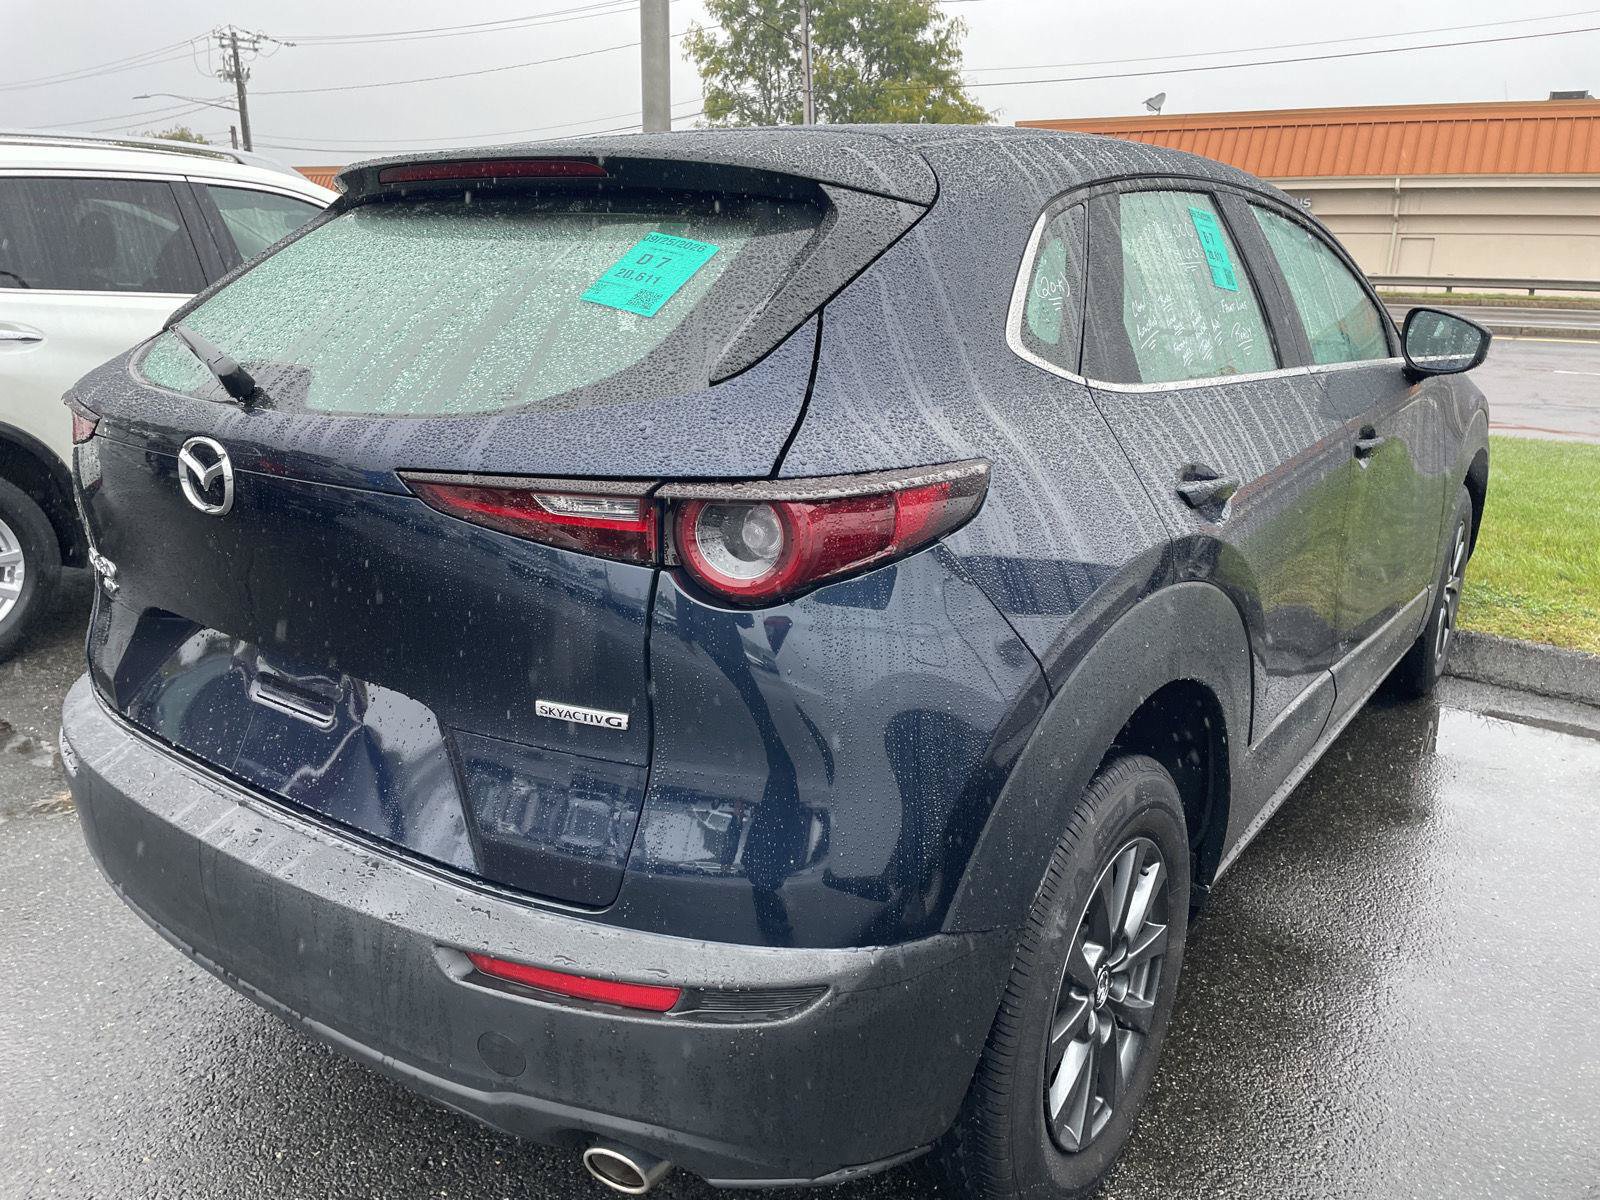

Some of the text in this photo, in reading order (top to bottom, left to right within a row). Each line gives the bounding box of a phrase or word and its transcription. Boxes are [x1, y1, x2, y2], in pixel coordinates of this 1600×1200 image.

[636, 253, 673, 268] D 7
[614, 268, 662, 285] 20.611
